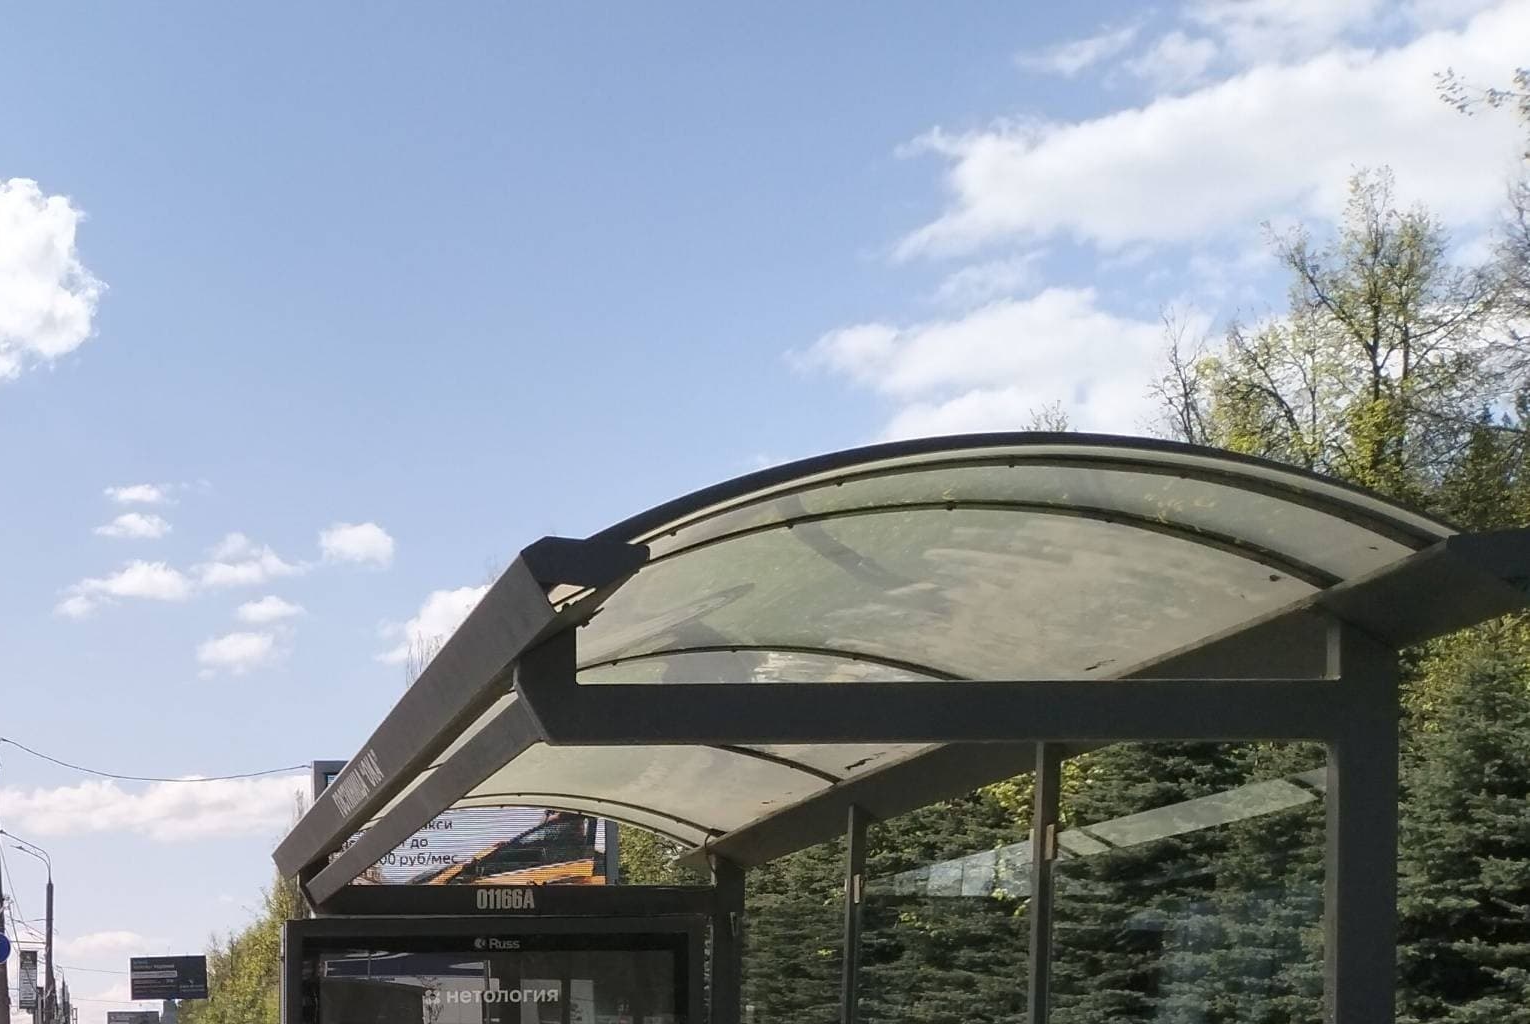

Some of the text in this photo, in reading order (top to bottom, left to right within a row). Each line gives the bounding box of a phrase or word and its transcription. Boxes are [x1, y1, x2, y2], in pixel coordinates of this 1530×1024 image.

[410, 838, 428, 849] до
[399, 853, 459, 867] руб/мес
[476, 888, 535, 910] 01166А
[488, 937, 521, 950] Russ
[446, 988, 560, 1004] нетология
